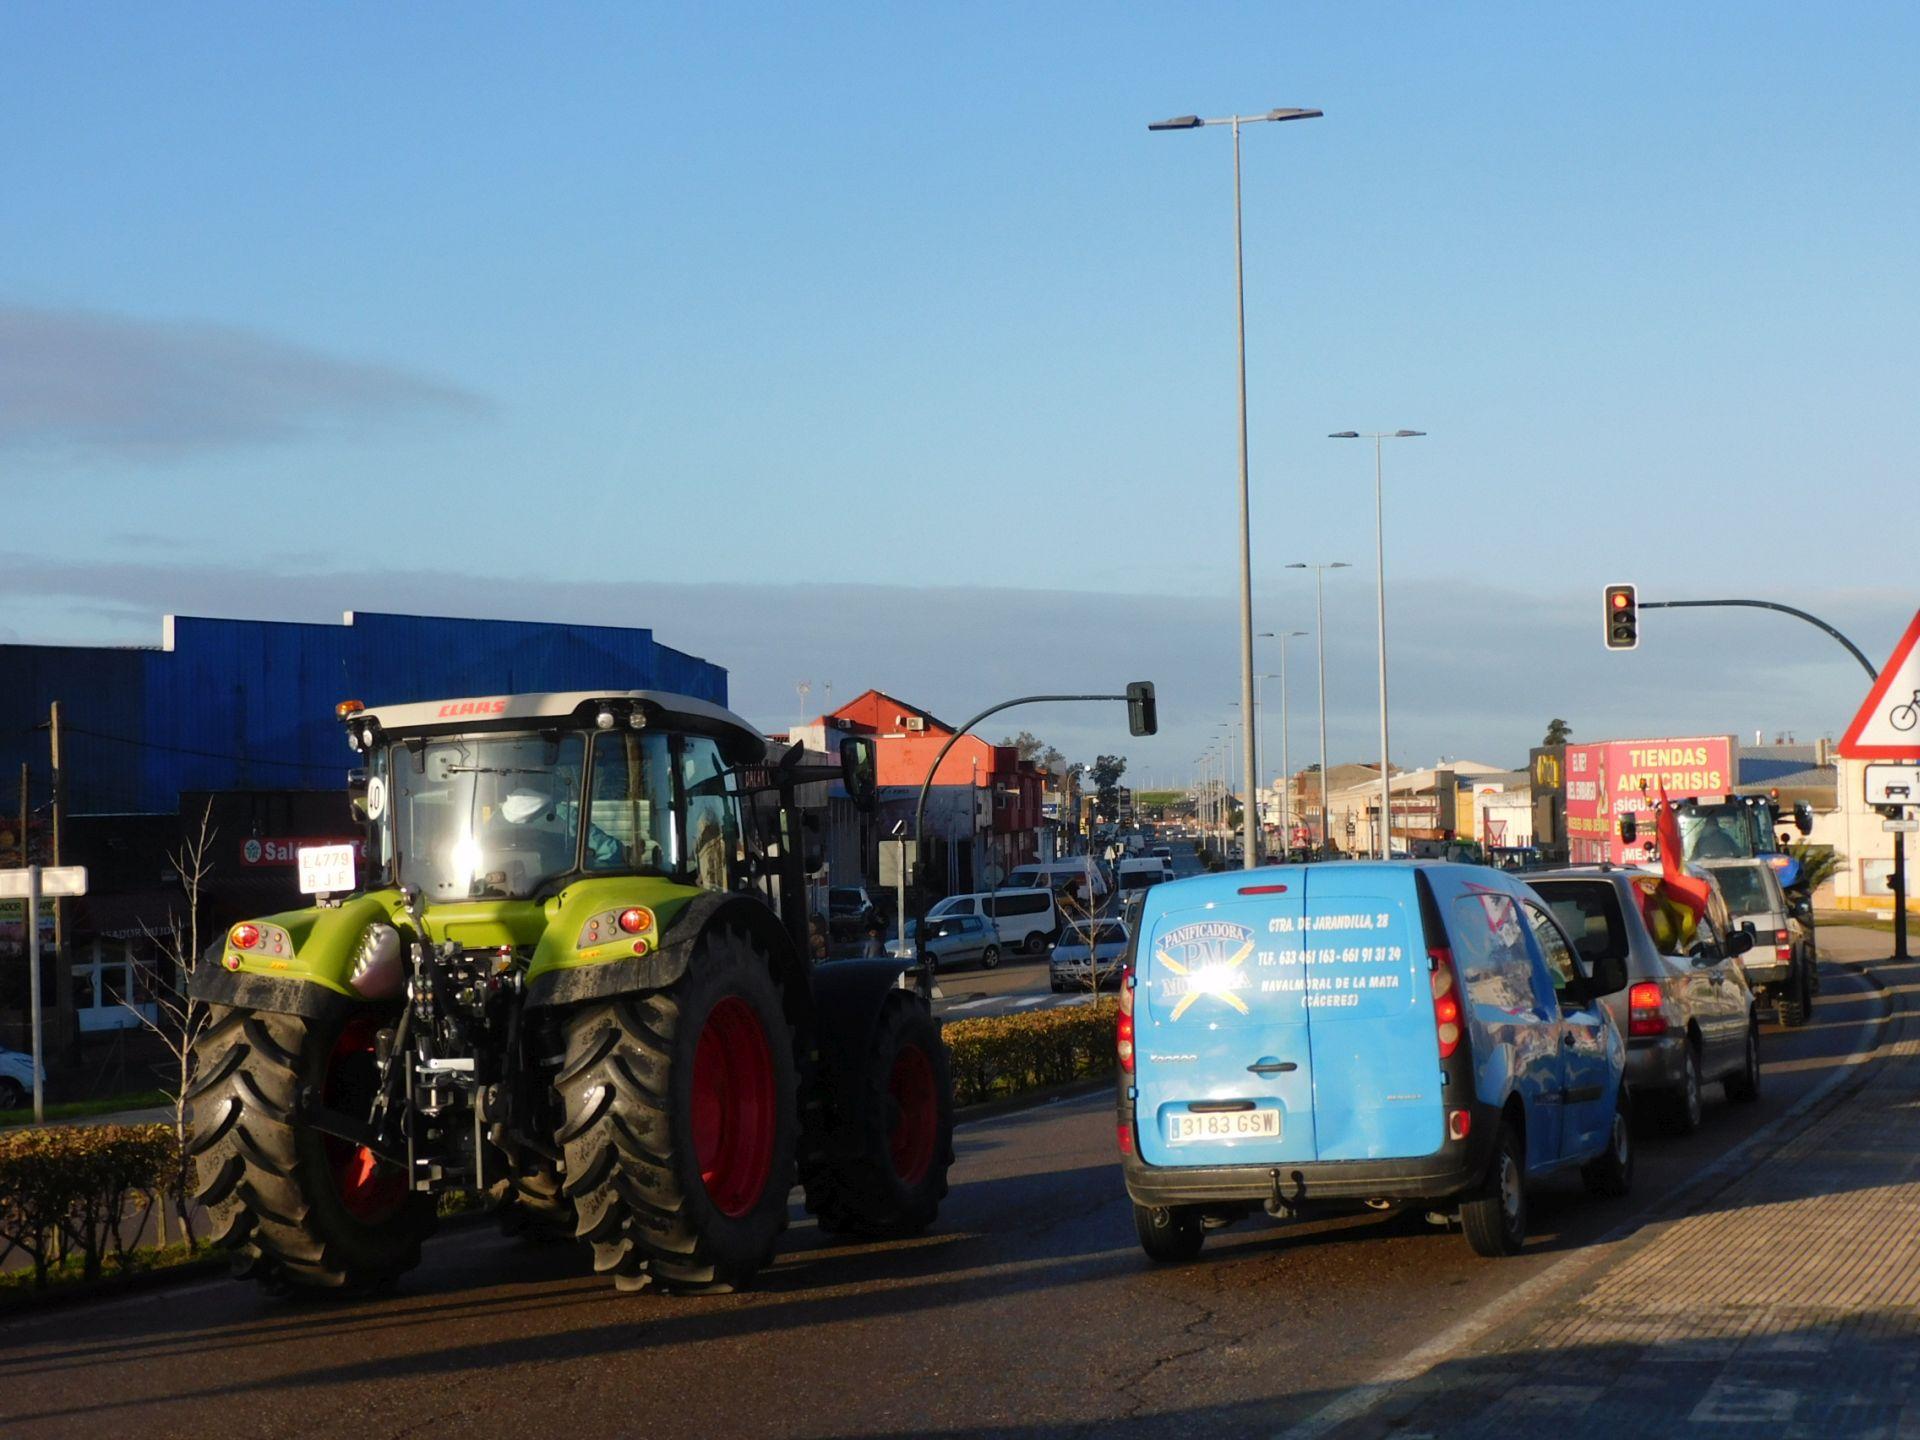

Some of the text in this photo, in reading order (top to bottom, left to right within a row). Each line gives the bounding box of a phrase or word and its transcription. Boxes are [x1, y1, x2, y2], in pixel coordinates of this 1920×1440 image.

[438, 701, 506, 717] CLAAS
[1630, 747, 1708, 767] TIENDAS
[1617, 771, 1721, 791] ANTICRISIS
[1268, 917, 1295, 933] CTRA.
[1297, 917, 1311, 931] DE
[1313, 914, 1374, 930] JARANDILLA,
[1165, 923, 1244, 948] PANIFICADORA
[1258, 951, 1277, 966] TLF.
[1261, 978, 1332, 992] NAVALMORAL
[1335, 977, 1350, 989] DE
[1352, 977, 1367, 989] LA
[1369, 976, 1399, 989] MATA
[1301, 993, 1359, 1008] (CÁCERES)
[1183, 1113, 1273, 1136] 3183 GSW
